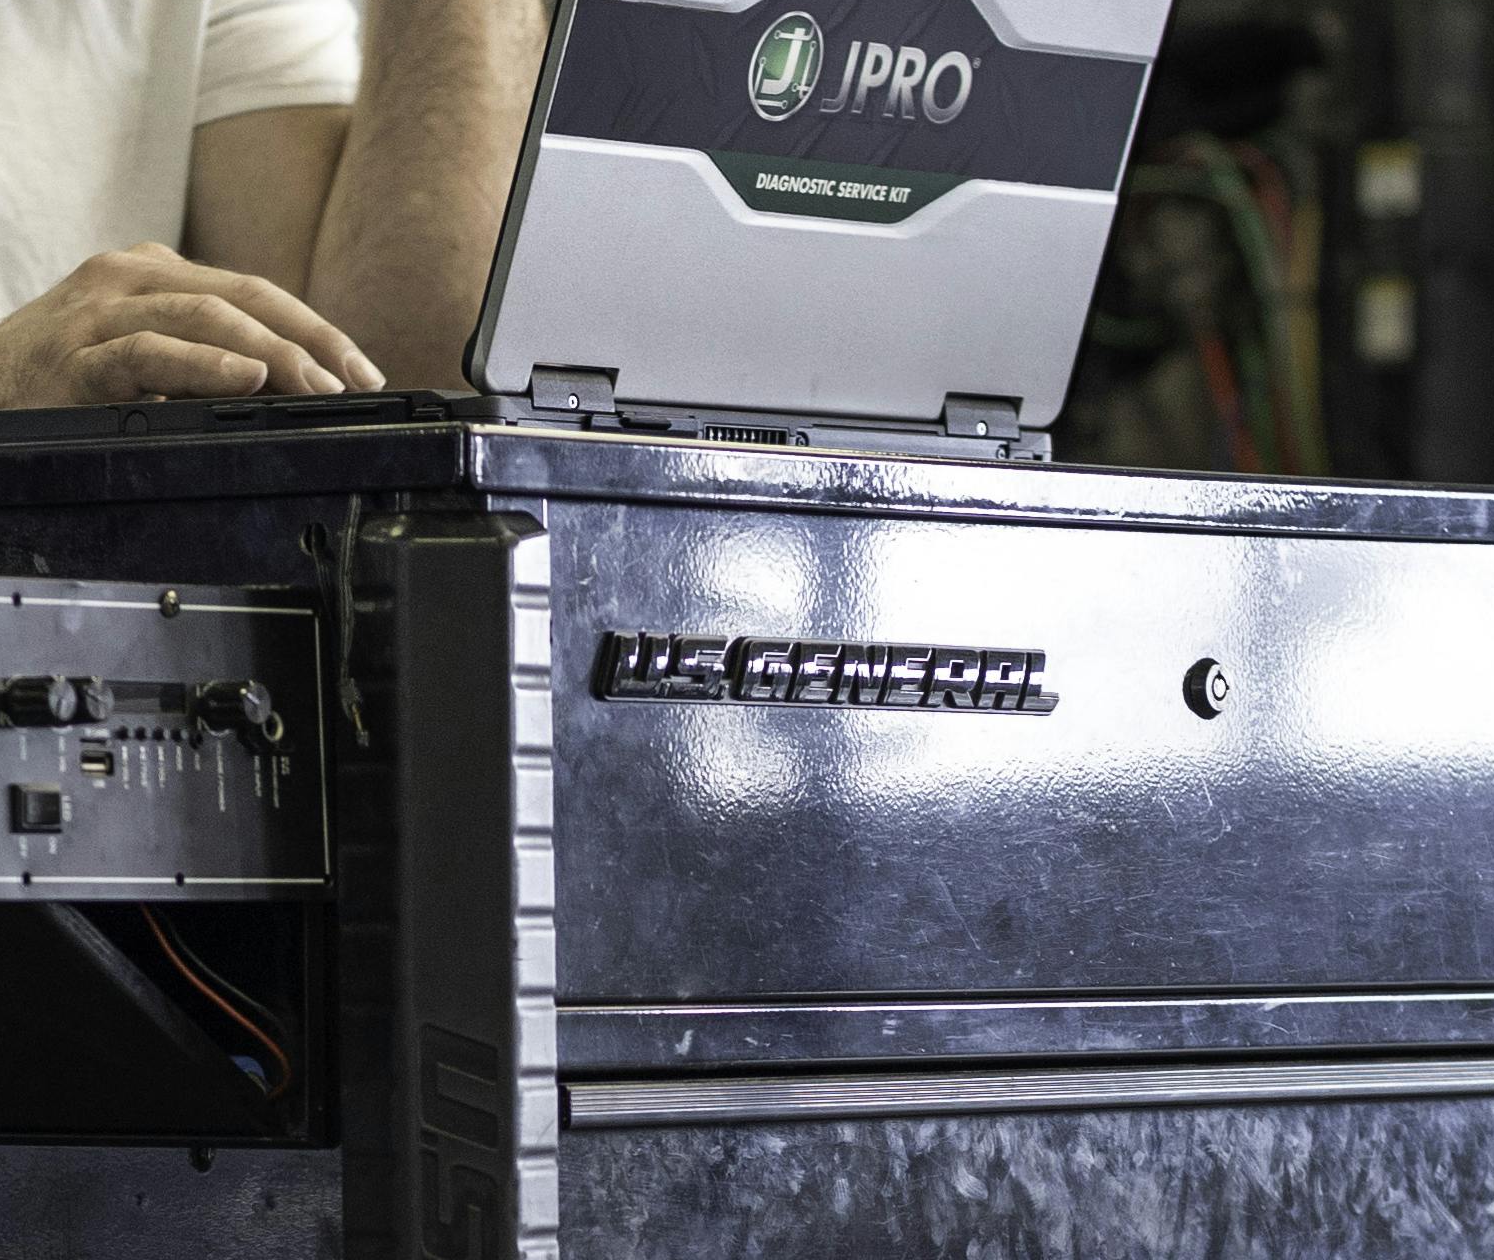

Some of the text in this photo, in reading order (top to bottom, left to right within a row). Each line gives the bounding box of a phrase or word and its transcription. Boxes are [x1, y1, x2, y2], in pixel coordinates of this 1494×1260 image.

[756, 172, 912, 204] DIAGNOSTIC SERVICE KIT
[724, 636, 1061, 716] GENERAL
